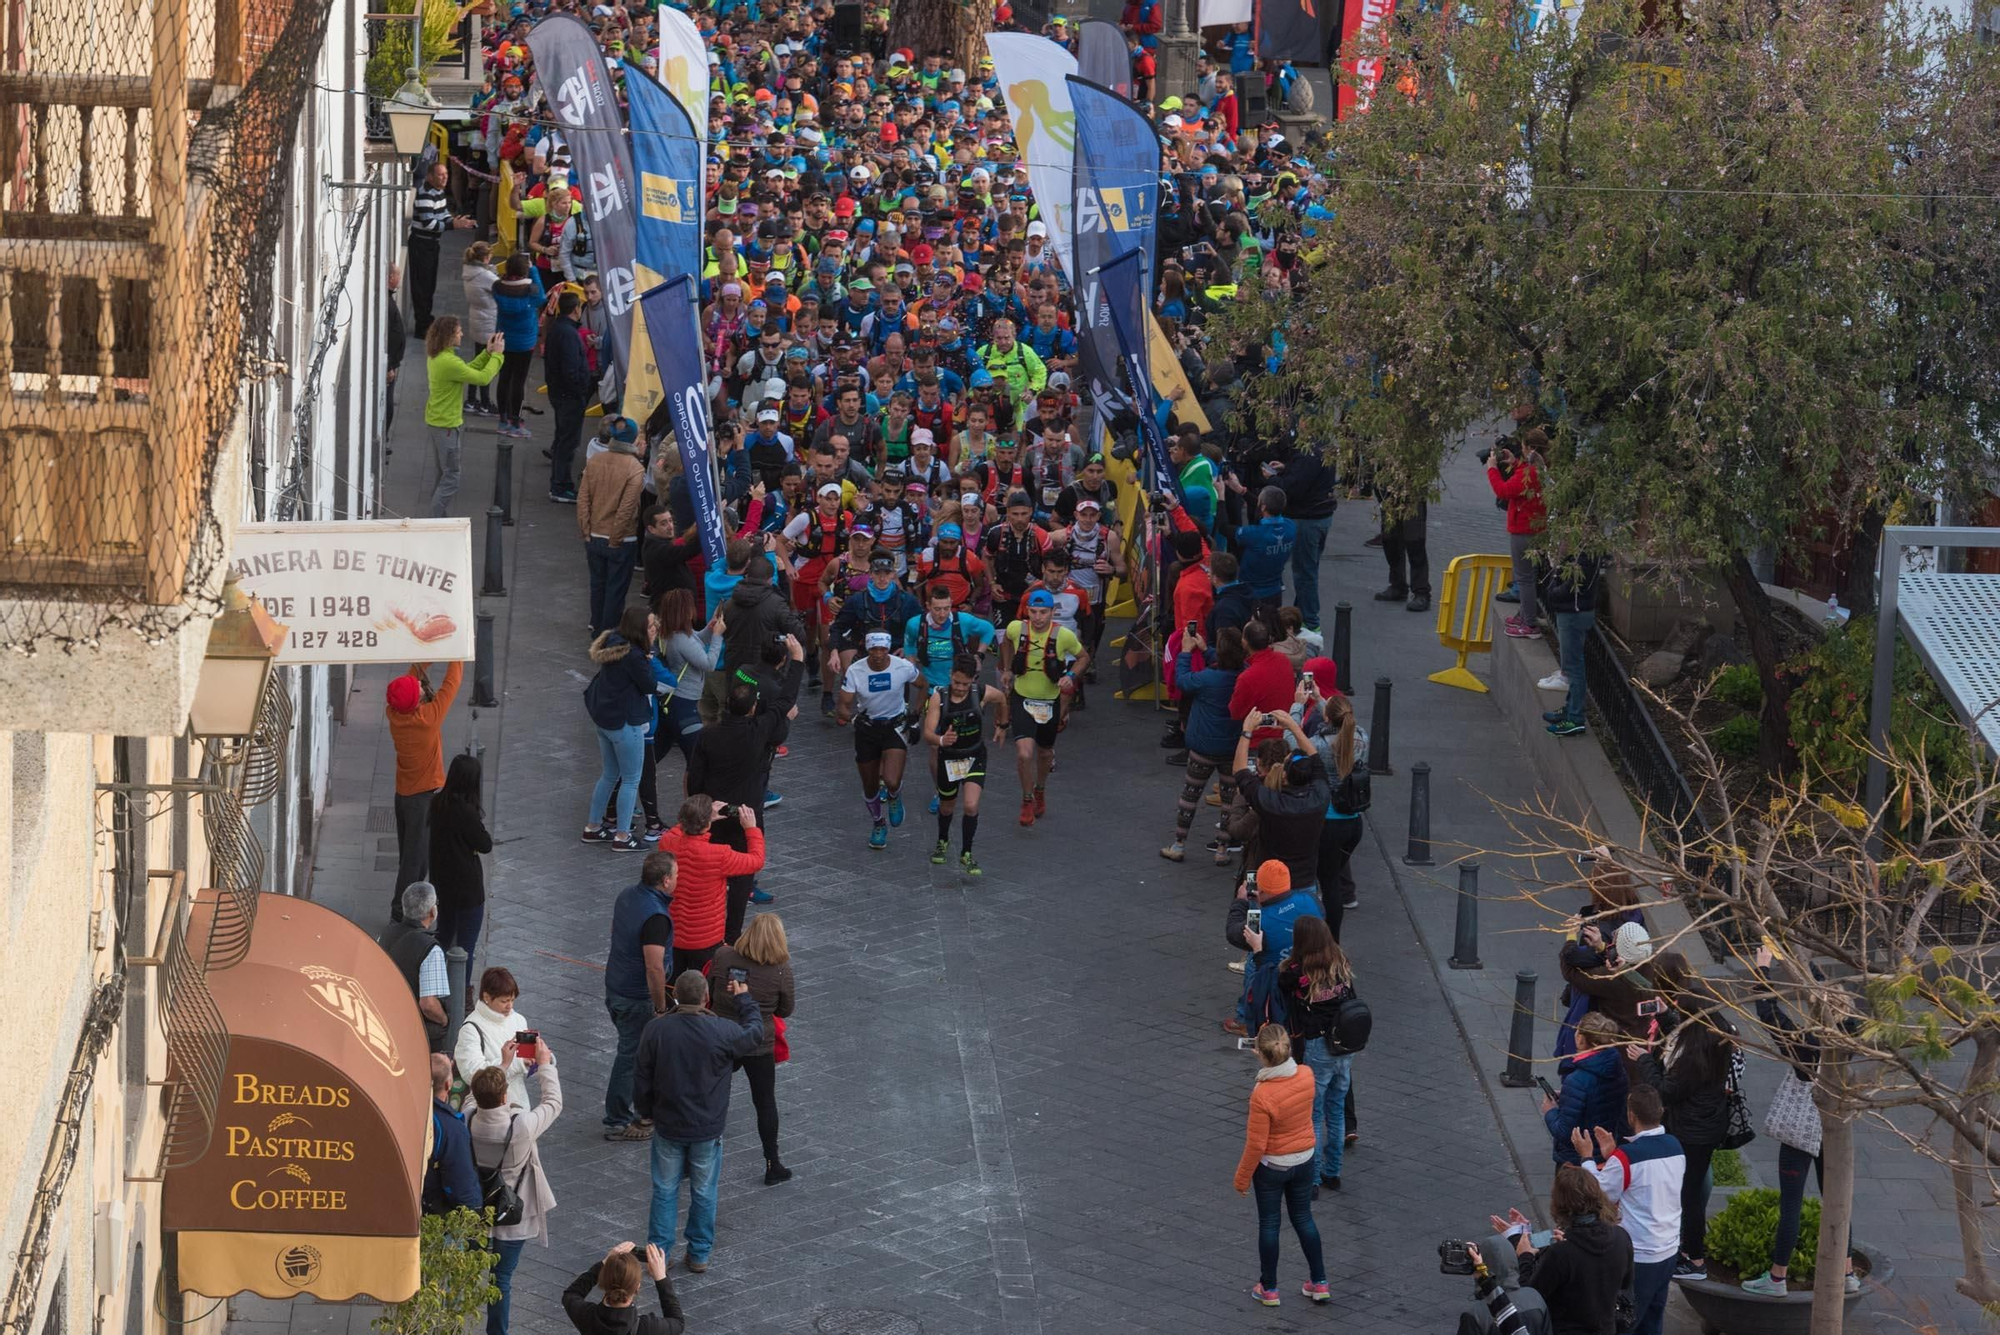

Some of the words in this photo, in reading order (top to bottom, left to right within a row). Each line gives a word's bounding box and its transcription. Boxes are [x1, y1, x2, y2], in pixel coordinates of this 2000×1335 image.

[229, 549, 322, 577] ANERA
[333, 549, 366, 572] DE
[376, 554, 457, 593] TUNTE
[257, 597, 295, 617] DE
[310, 596, 370, 617] 1948
[292, 631, 328, 648] 127
[337, 630, 378, 648] 428
[233, 1073, 351, 1108] BREADS
[225, 1126, 355, 1162] PASTRIES
[230, 1179, 348, 1210] COFFEE
